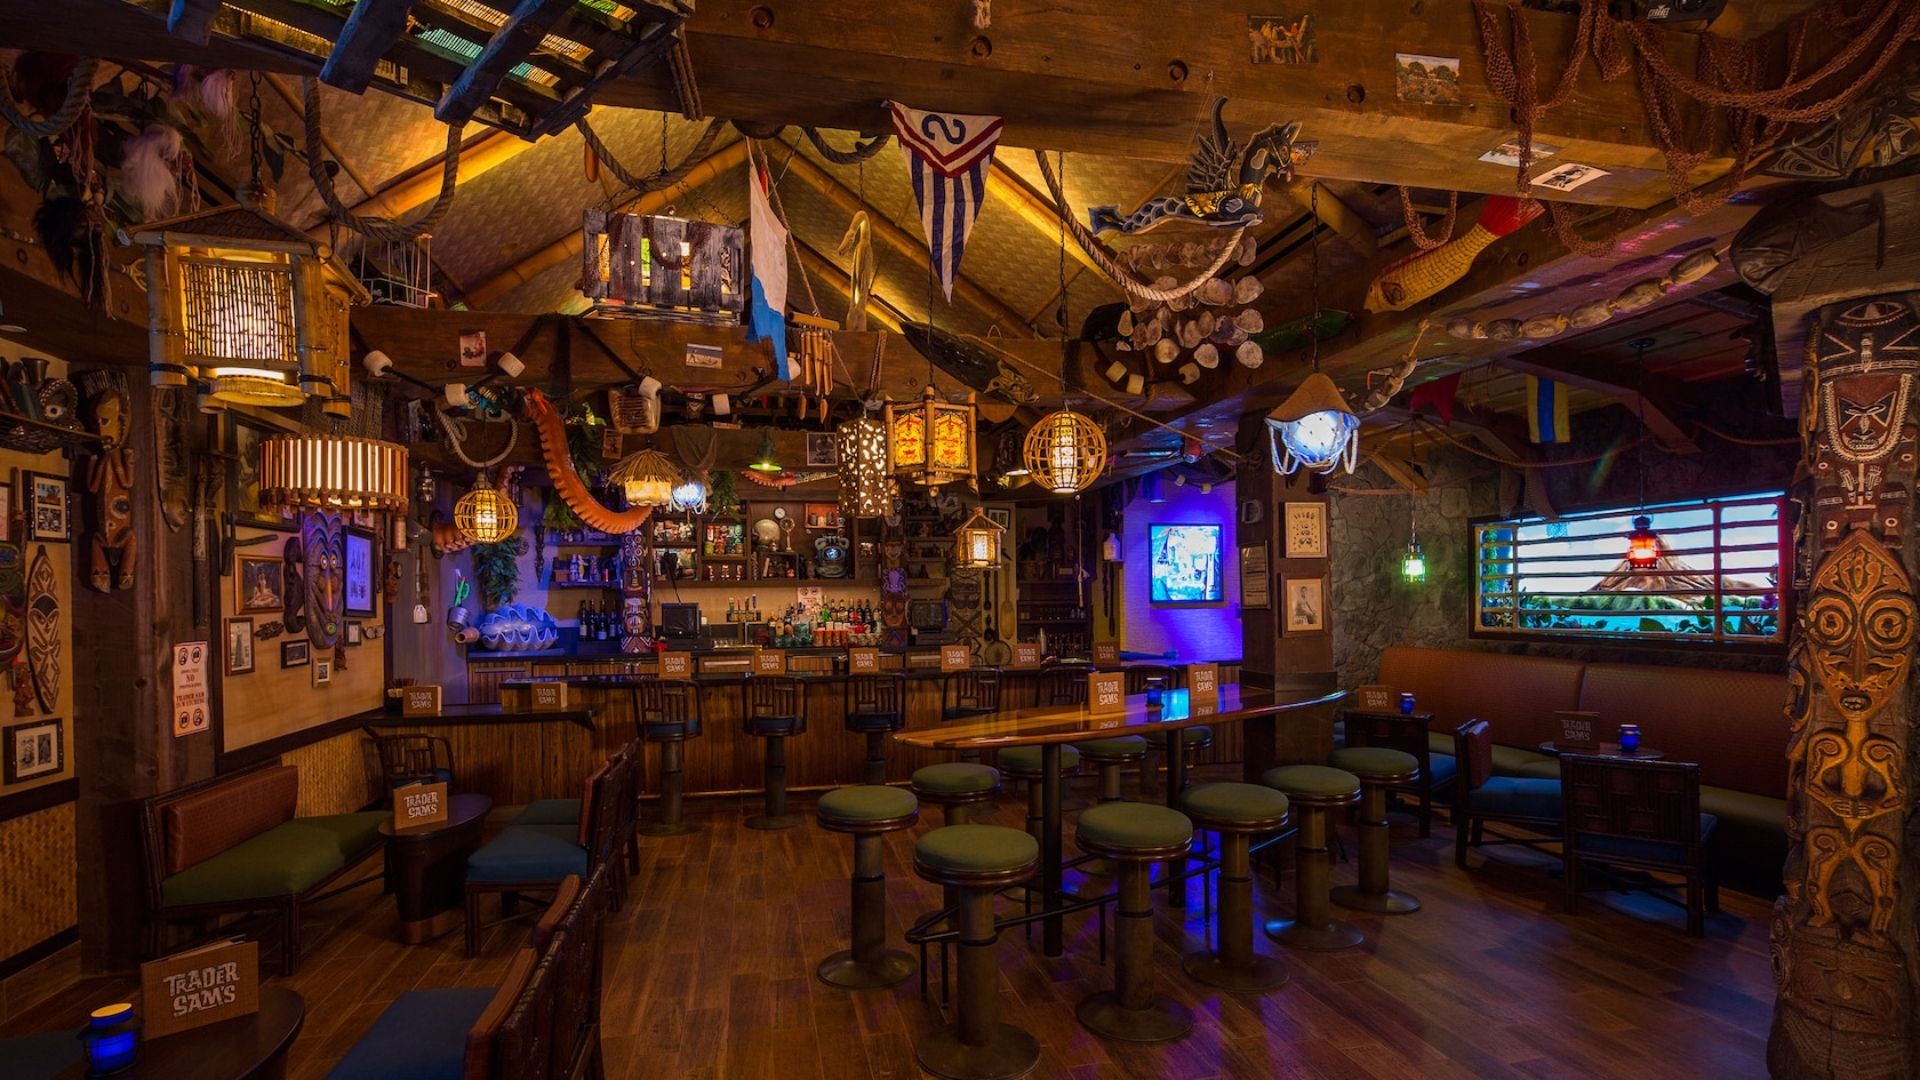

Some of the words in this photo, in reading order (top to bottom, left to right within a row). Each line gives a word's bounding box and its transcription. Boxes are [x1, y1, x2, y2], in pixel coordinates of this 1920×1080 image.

[1194, 670, 1214, 682] TRADER
[1096, 680, 1119, 694] TRADER
[409, 692, 433, 701] TRADER
[1561, 719, 1591, 732] TRADER
[403, 791, 439, 808] TRADER
[408, 804, 437, 819] SAM'S
[162, 961, 241, 997] TRADER
[173, 984, 236, 1017] SAM'S
